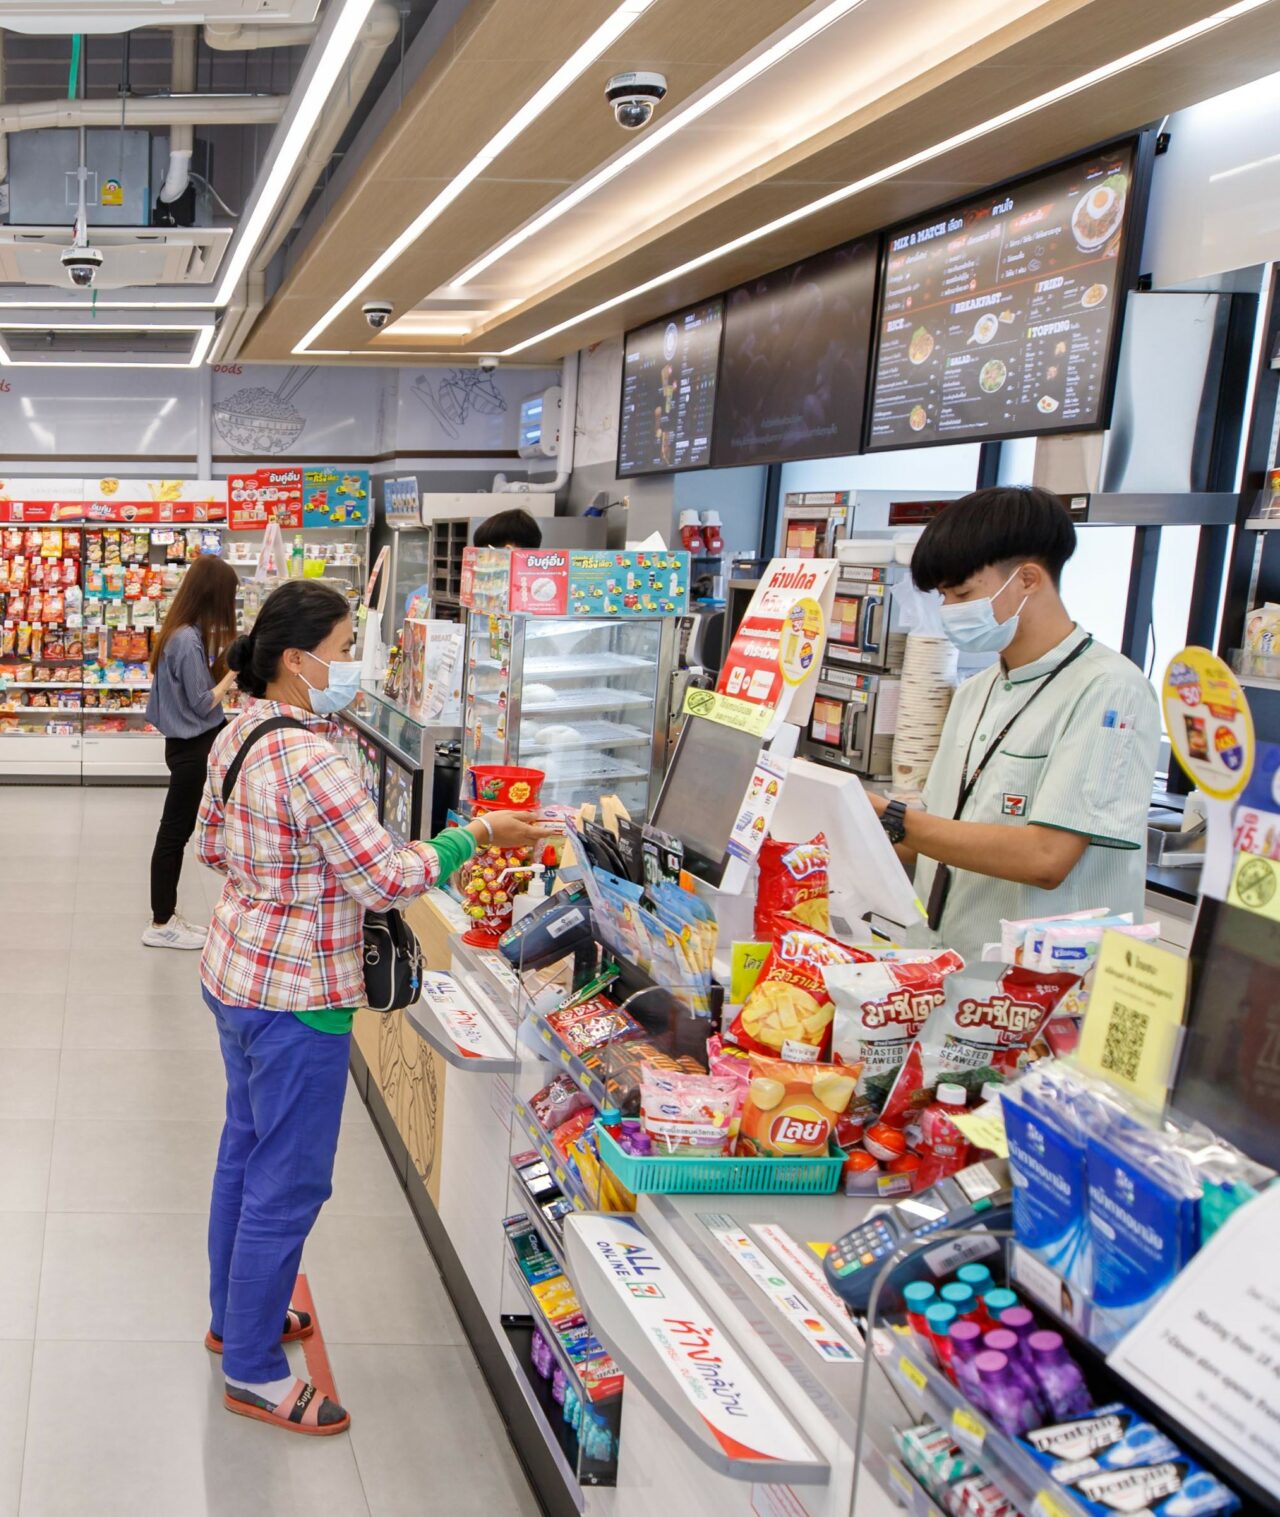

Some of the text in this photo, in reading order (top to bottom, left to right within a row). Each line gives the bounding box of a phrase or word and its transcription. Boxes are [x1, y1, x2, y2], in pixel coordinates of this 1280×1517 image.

[1039, 277, 1064, 292] FRIED
[954, 292, 1002, 314] BREAKFAST
[1031, 320, 1070, 338] TOPPING
[214, 363, 242, 375] oods
[768, 563, 818, 591] ห่างไกล
[860, 1046, 904, 1057] ROASTED
[943, 1041, 989, 1061] ROASTED
[775, 1117, 823, 1145] เลย์
[596, 1241, 632, 1277] ONLINE
[616, 1241, 661, 1277] ALL
[1038, 1415, 1114, 1451] Dentyne
[1087, 1465, 1170, 1501] Dentyne
